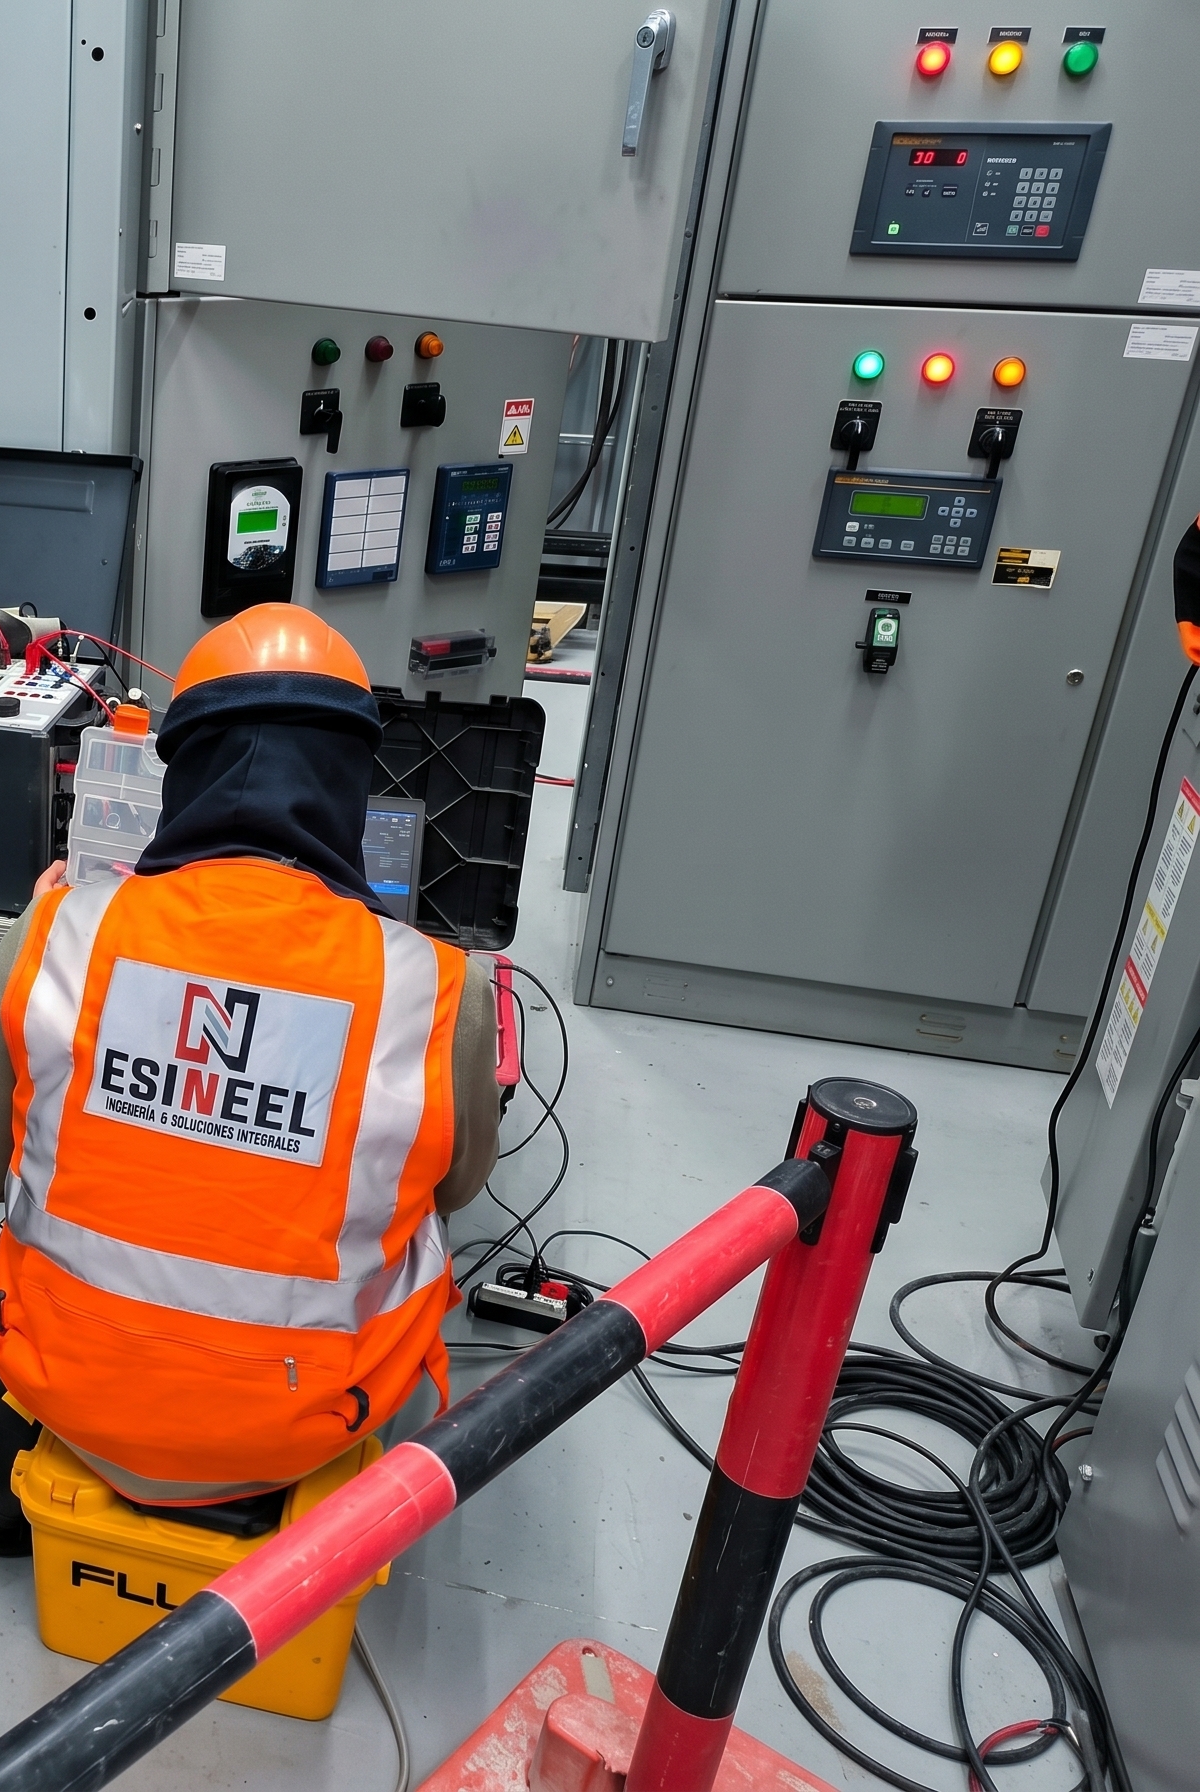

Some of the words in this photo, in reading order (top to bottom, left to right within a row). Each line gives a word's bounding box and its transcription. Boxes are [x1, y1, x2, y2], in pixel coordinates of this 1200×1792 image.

[100, 1047, 316, 1138] ESINEEL
[170, 1114, 235, 1140] SOLUCIONES
[236, 1129, 301, 1154] INTEGRALES
